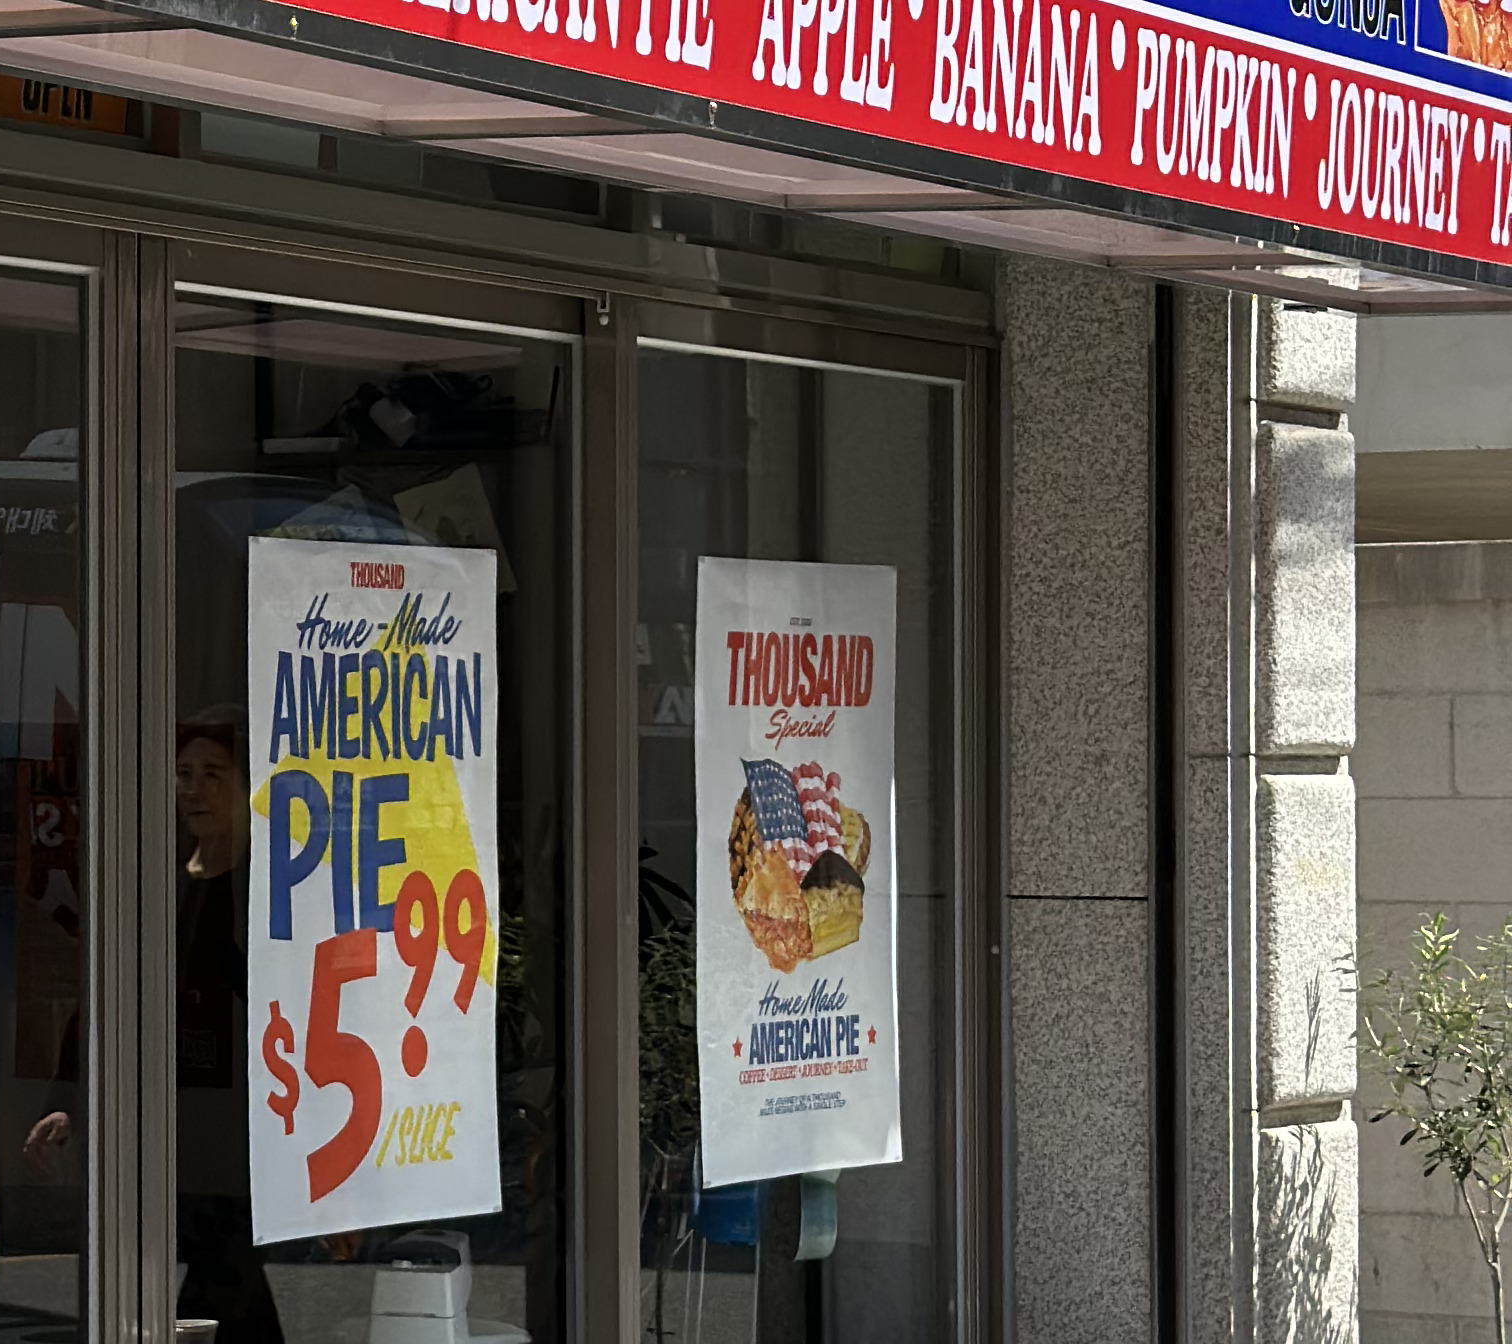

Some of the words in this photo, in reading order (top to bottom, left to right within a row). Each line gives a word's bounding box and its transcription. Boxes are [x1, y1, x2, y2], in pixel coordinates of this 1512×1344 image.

[1131, 26, 1296, 199] PUMPKIN
[1318, 79, 1468, 235] JOURNEY
[350, 562, 405, 590] THOUSAND
[269, 650, 482, 764] AMERICAN
[727, 631, 874, 707] THOUSAND
[765, 709, 836, 751] Special
[269, 768, 409, 941] PIE
[749, 1016, 831, 1065] AMERICAN
[835, 1014, 859, 1056] PIE
